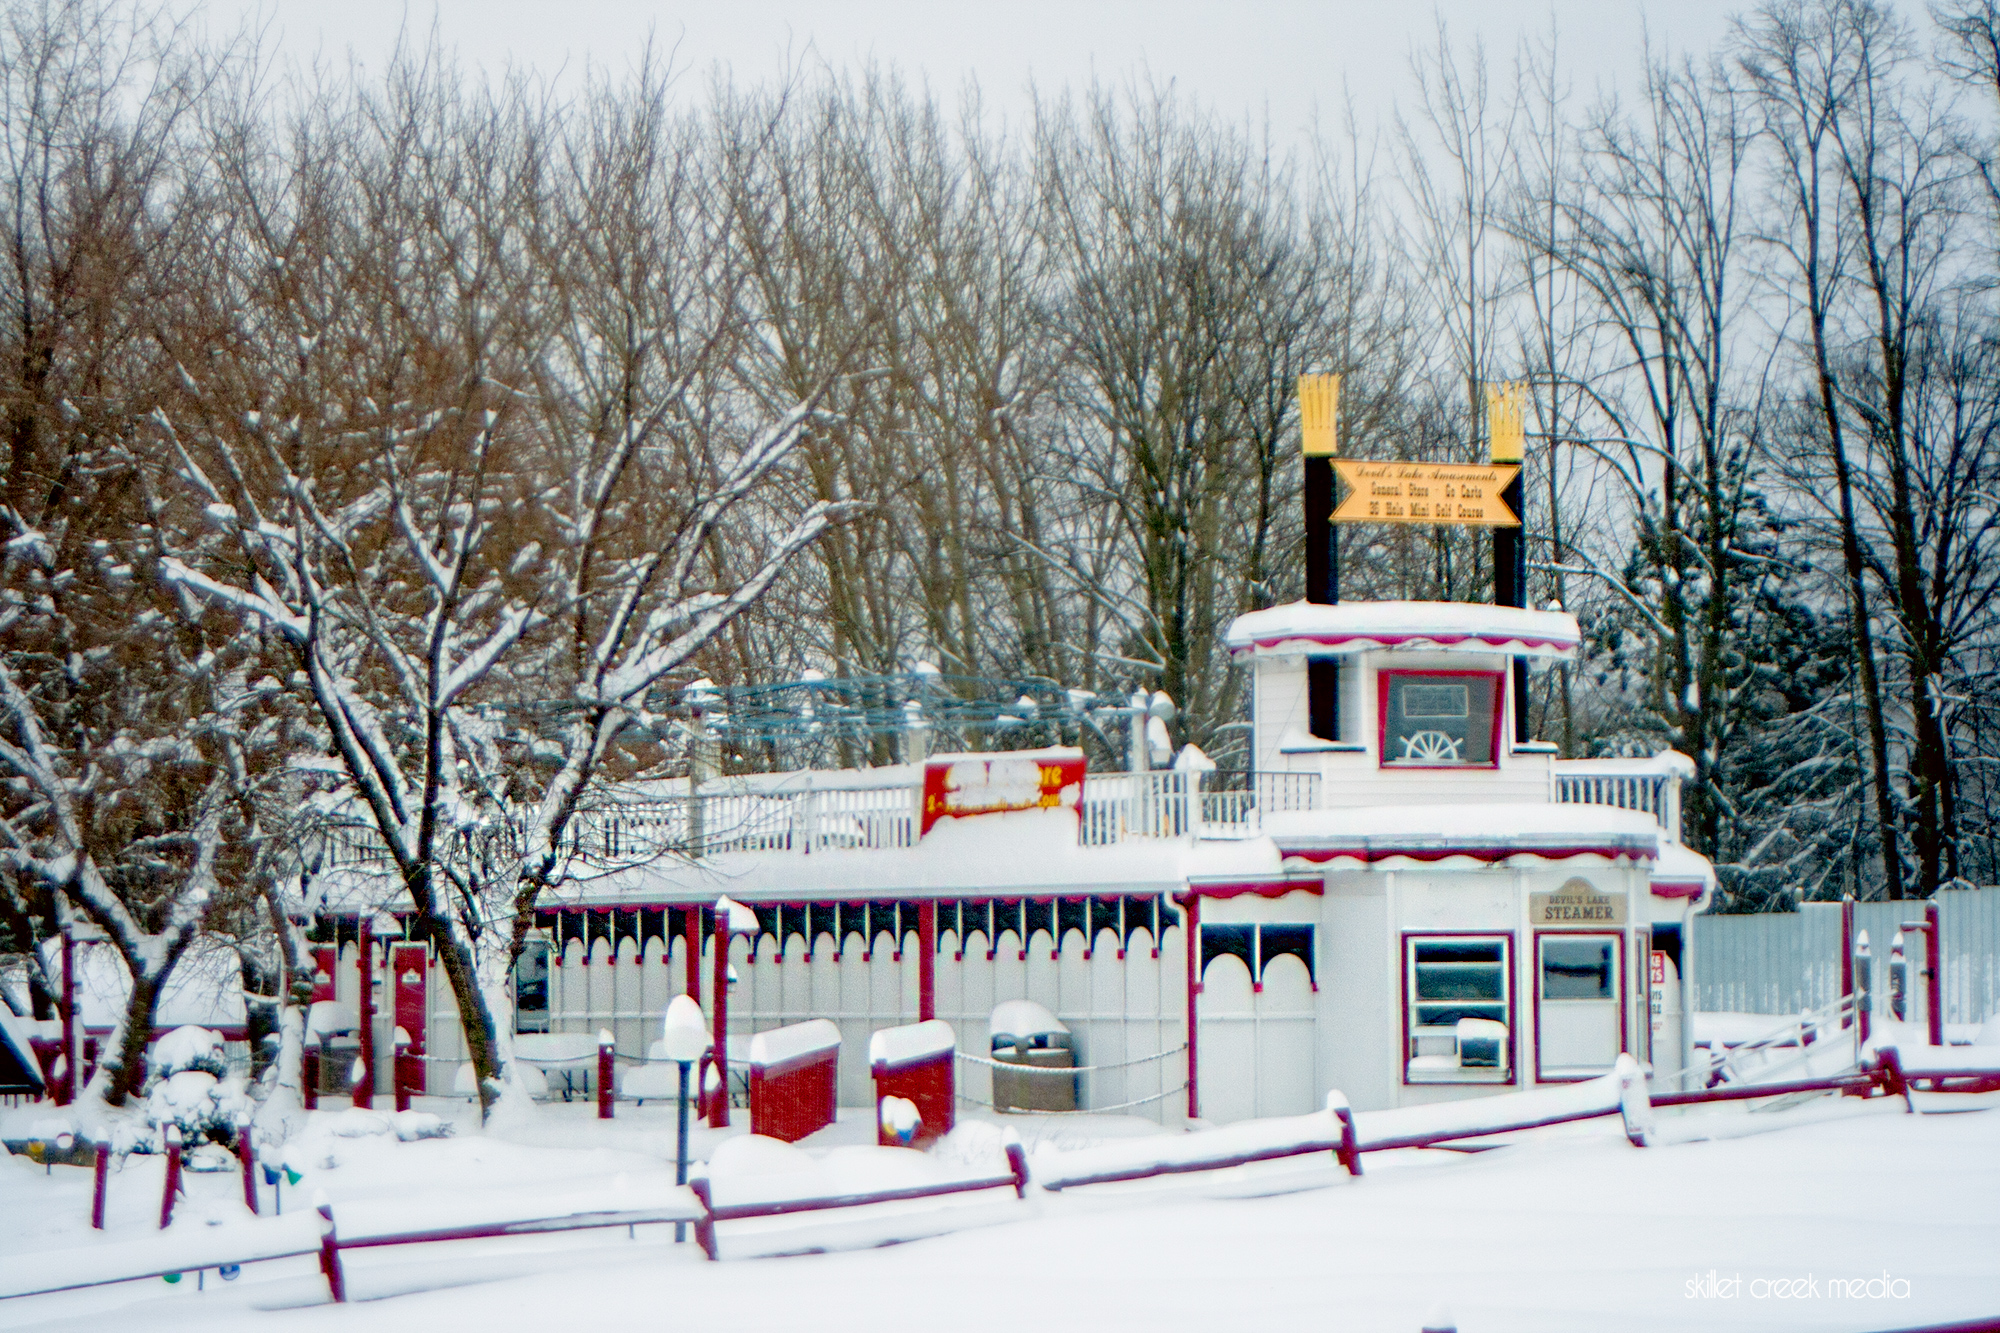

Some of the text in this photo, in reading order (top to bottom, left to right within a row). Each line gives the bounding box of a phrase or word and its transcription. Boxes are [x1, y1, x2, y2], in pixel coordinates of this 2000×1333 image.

[1356, 465, 1497, 481] Devil's Lake Amusements
[1371, 481, 1402, 496] General
[1409, 482, 1429, 497] Store
[1445, 483, 1456, 498] Go
[1461, 483, 1482, 498] Carts
[1386, 501, 1404, 516] Hole
[1410, 502, 1430, 517] Mini
[1435, 503, 1452, 517] Golf
[1457, 503, 1483, 518] Course
[1549, 895, 1611, 905] DEVIL'S LAKE
[1544, 906, 1615, 920] STEAMER
